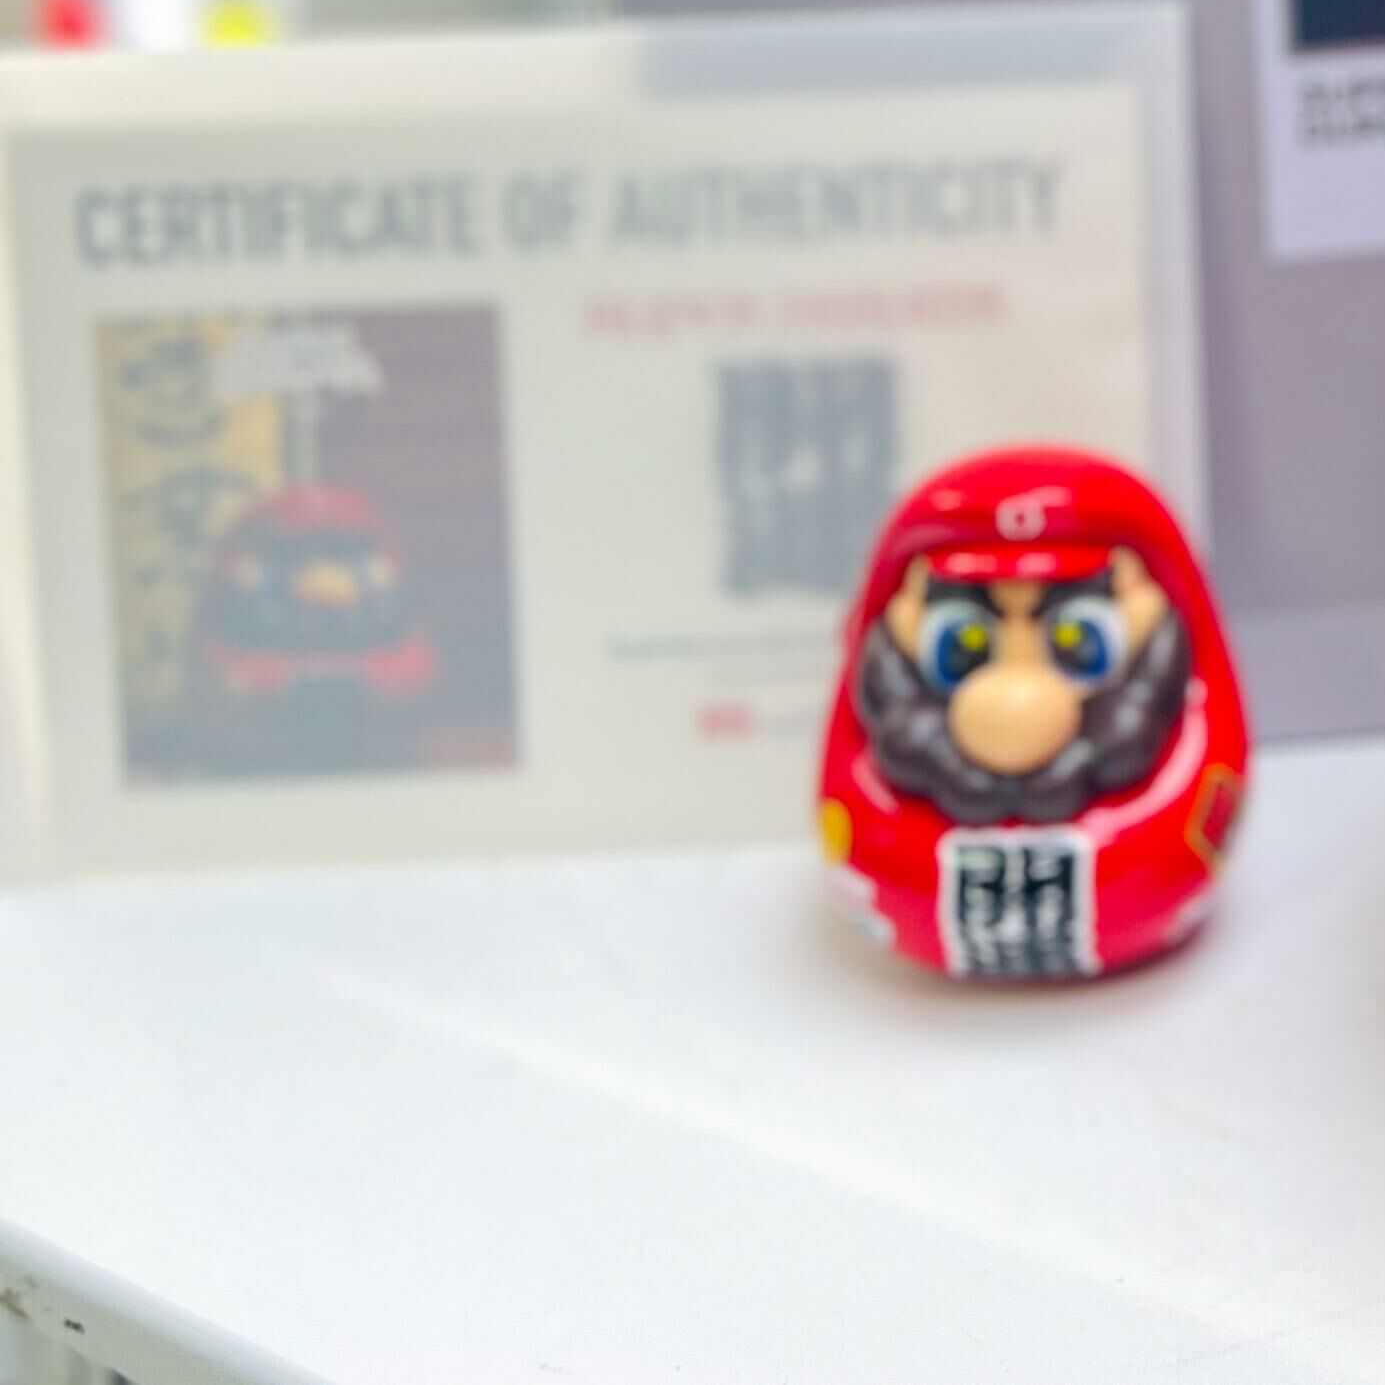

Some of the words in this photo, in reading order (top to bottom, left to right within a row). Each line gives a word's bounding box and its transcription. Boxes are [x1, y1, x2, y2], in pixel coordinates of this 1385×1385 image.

[74, 172, 488, 268] CERTIFICATE
[502, 173, 584, 255] OF
[607, 156, 1058, 249] AUTHENTICITY
